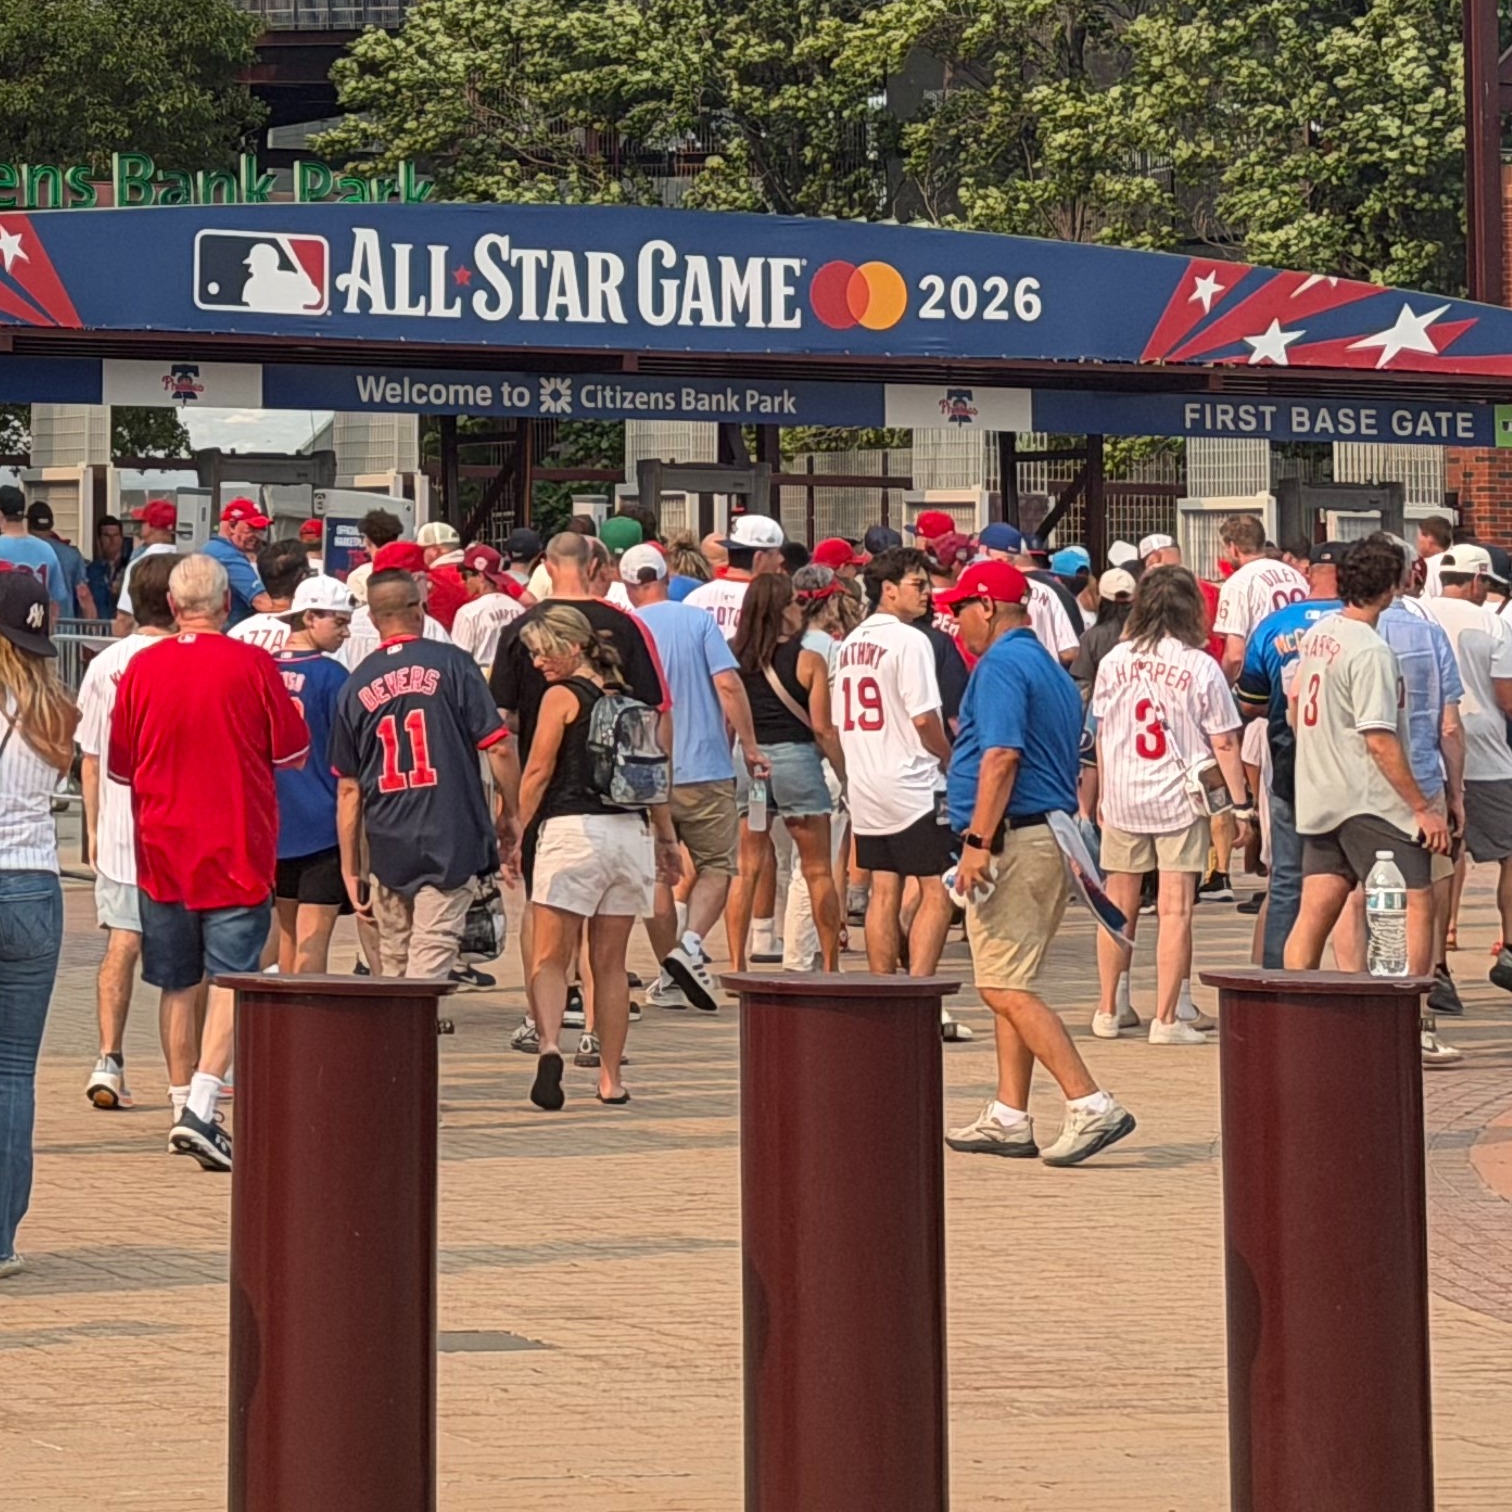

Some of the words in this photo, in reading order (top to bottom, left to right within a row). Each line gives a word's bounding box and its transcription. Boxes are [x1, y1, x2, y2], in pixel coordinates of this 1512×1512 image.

[112, 150, 278, 208] Bank
[335, 227, 462, 319] ALL
[471, 233, 626, 325] STAR
[638, 238, 802, 330] GAME
[918, 274, 1043, 323] 2026
[355, 373, 493, 408] Welcome
[500, 378, 530, 409] to
[579, 383, 677, 412] Citizens
[682, 386, 741, 413] Bank
[746, 388, 797, 415] Park
[1184, 402, 1278, 432] FIRST
[1291, 406, 1378, 436] BASE
[1390, 409, 1475, 439] GATE
[1114, 659, 1192, 692] HARPER
[1303, 673, 1321, 727] 3
[841, 676, 885, 733] 19
[1134, 697, 1167, 760] 3
[375, 708, 438, 794] 11
